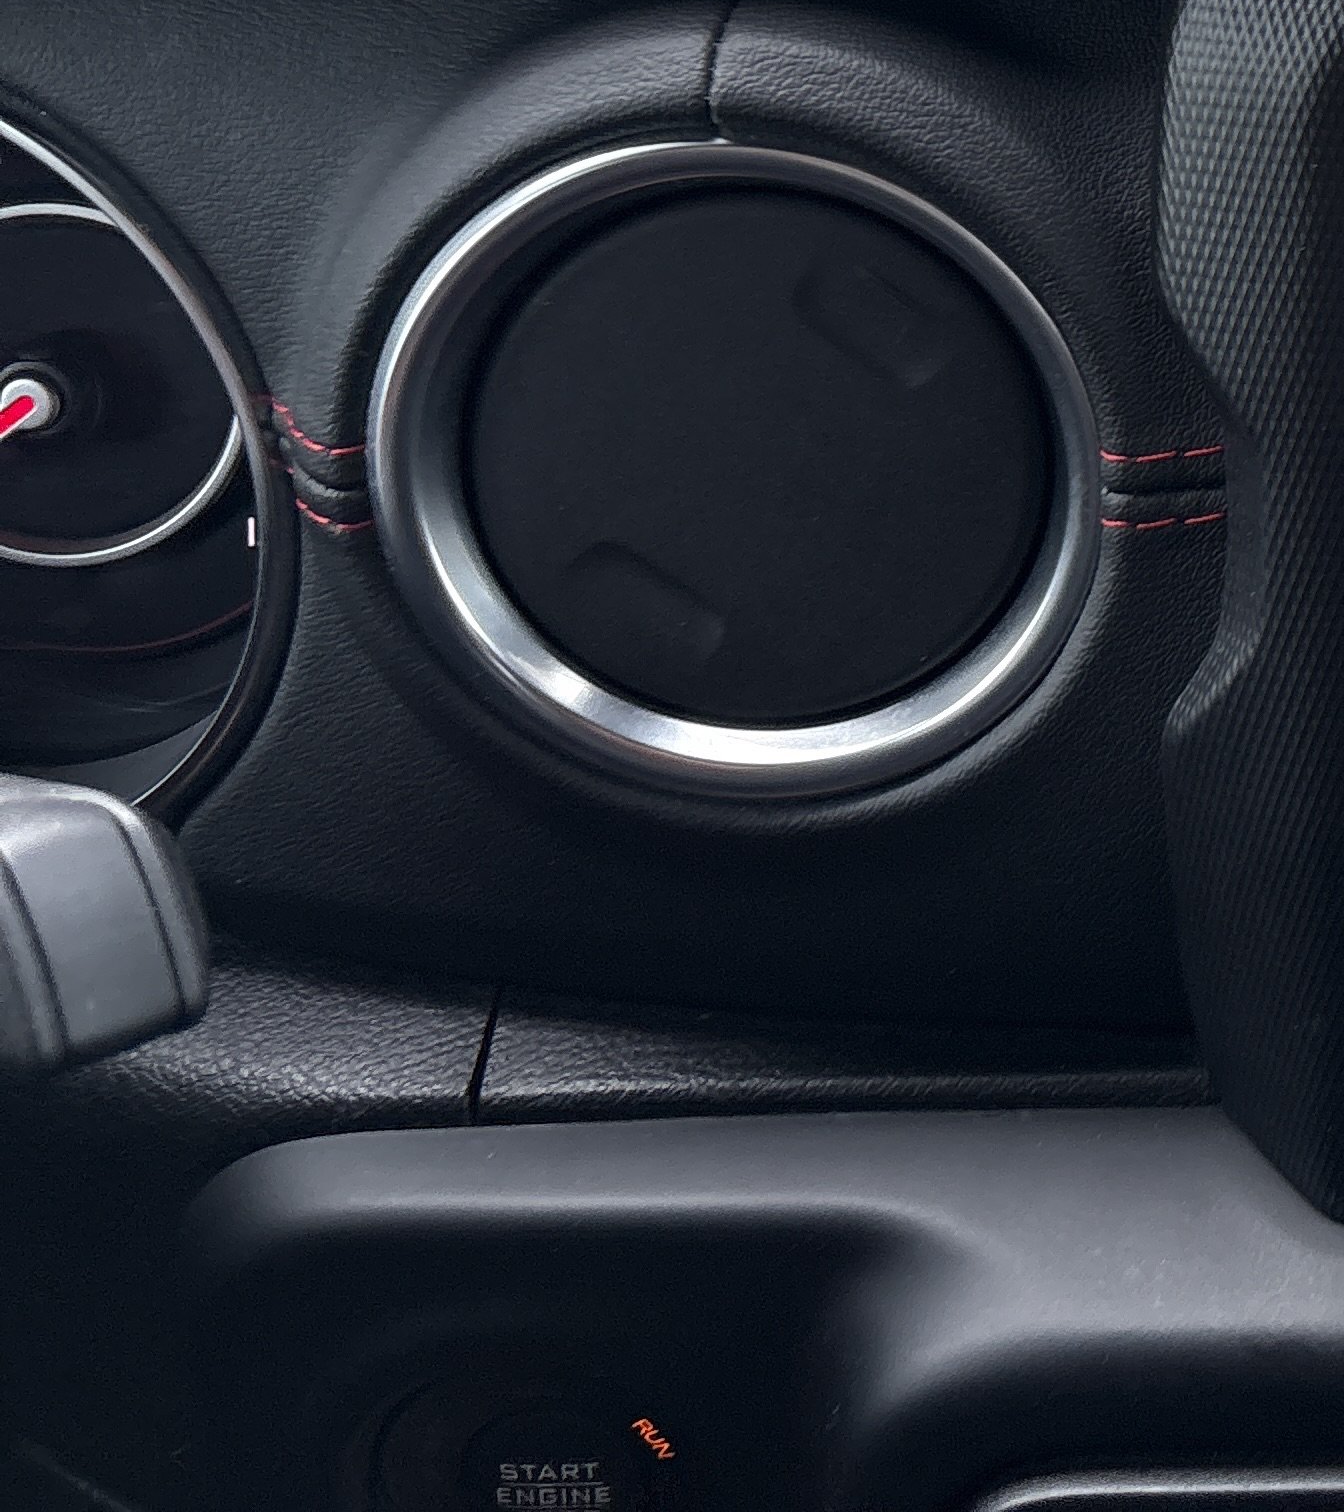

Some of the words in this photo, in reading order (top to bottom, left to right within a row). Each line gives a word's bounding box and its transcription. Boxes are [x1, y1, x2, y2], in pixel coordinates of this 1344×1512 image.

[631, 1418, 675, 1460] RUN
[499, 1462, 599, 1481] START
[497, 1486, 610, 1505] ENGINE
